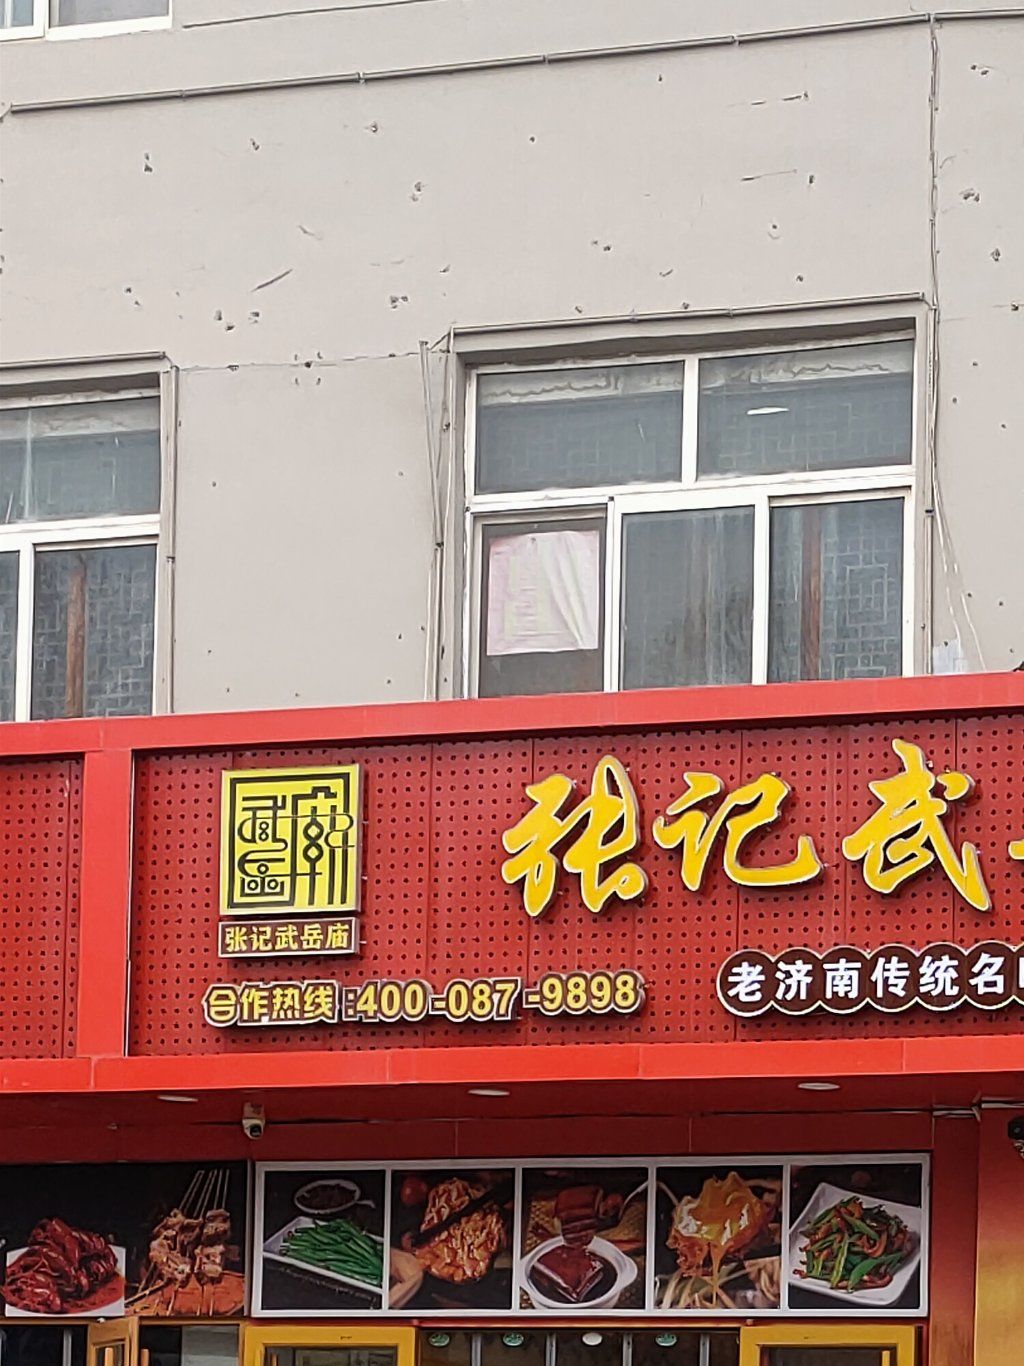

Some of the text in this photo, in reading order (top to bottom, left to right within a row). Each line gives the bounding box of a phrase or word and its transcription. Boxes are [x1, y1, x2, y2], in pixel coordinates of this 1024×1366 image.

[223, 923, 349, 955] 张记武岳庙
